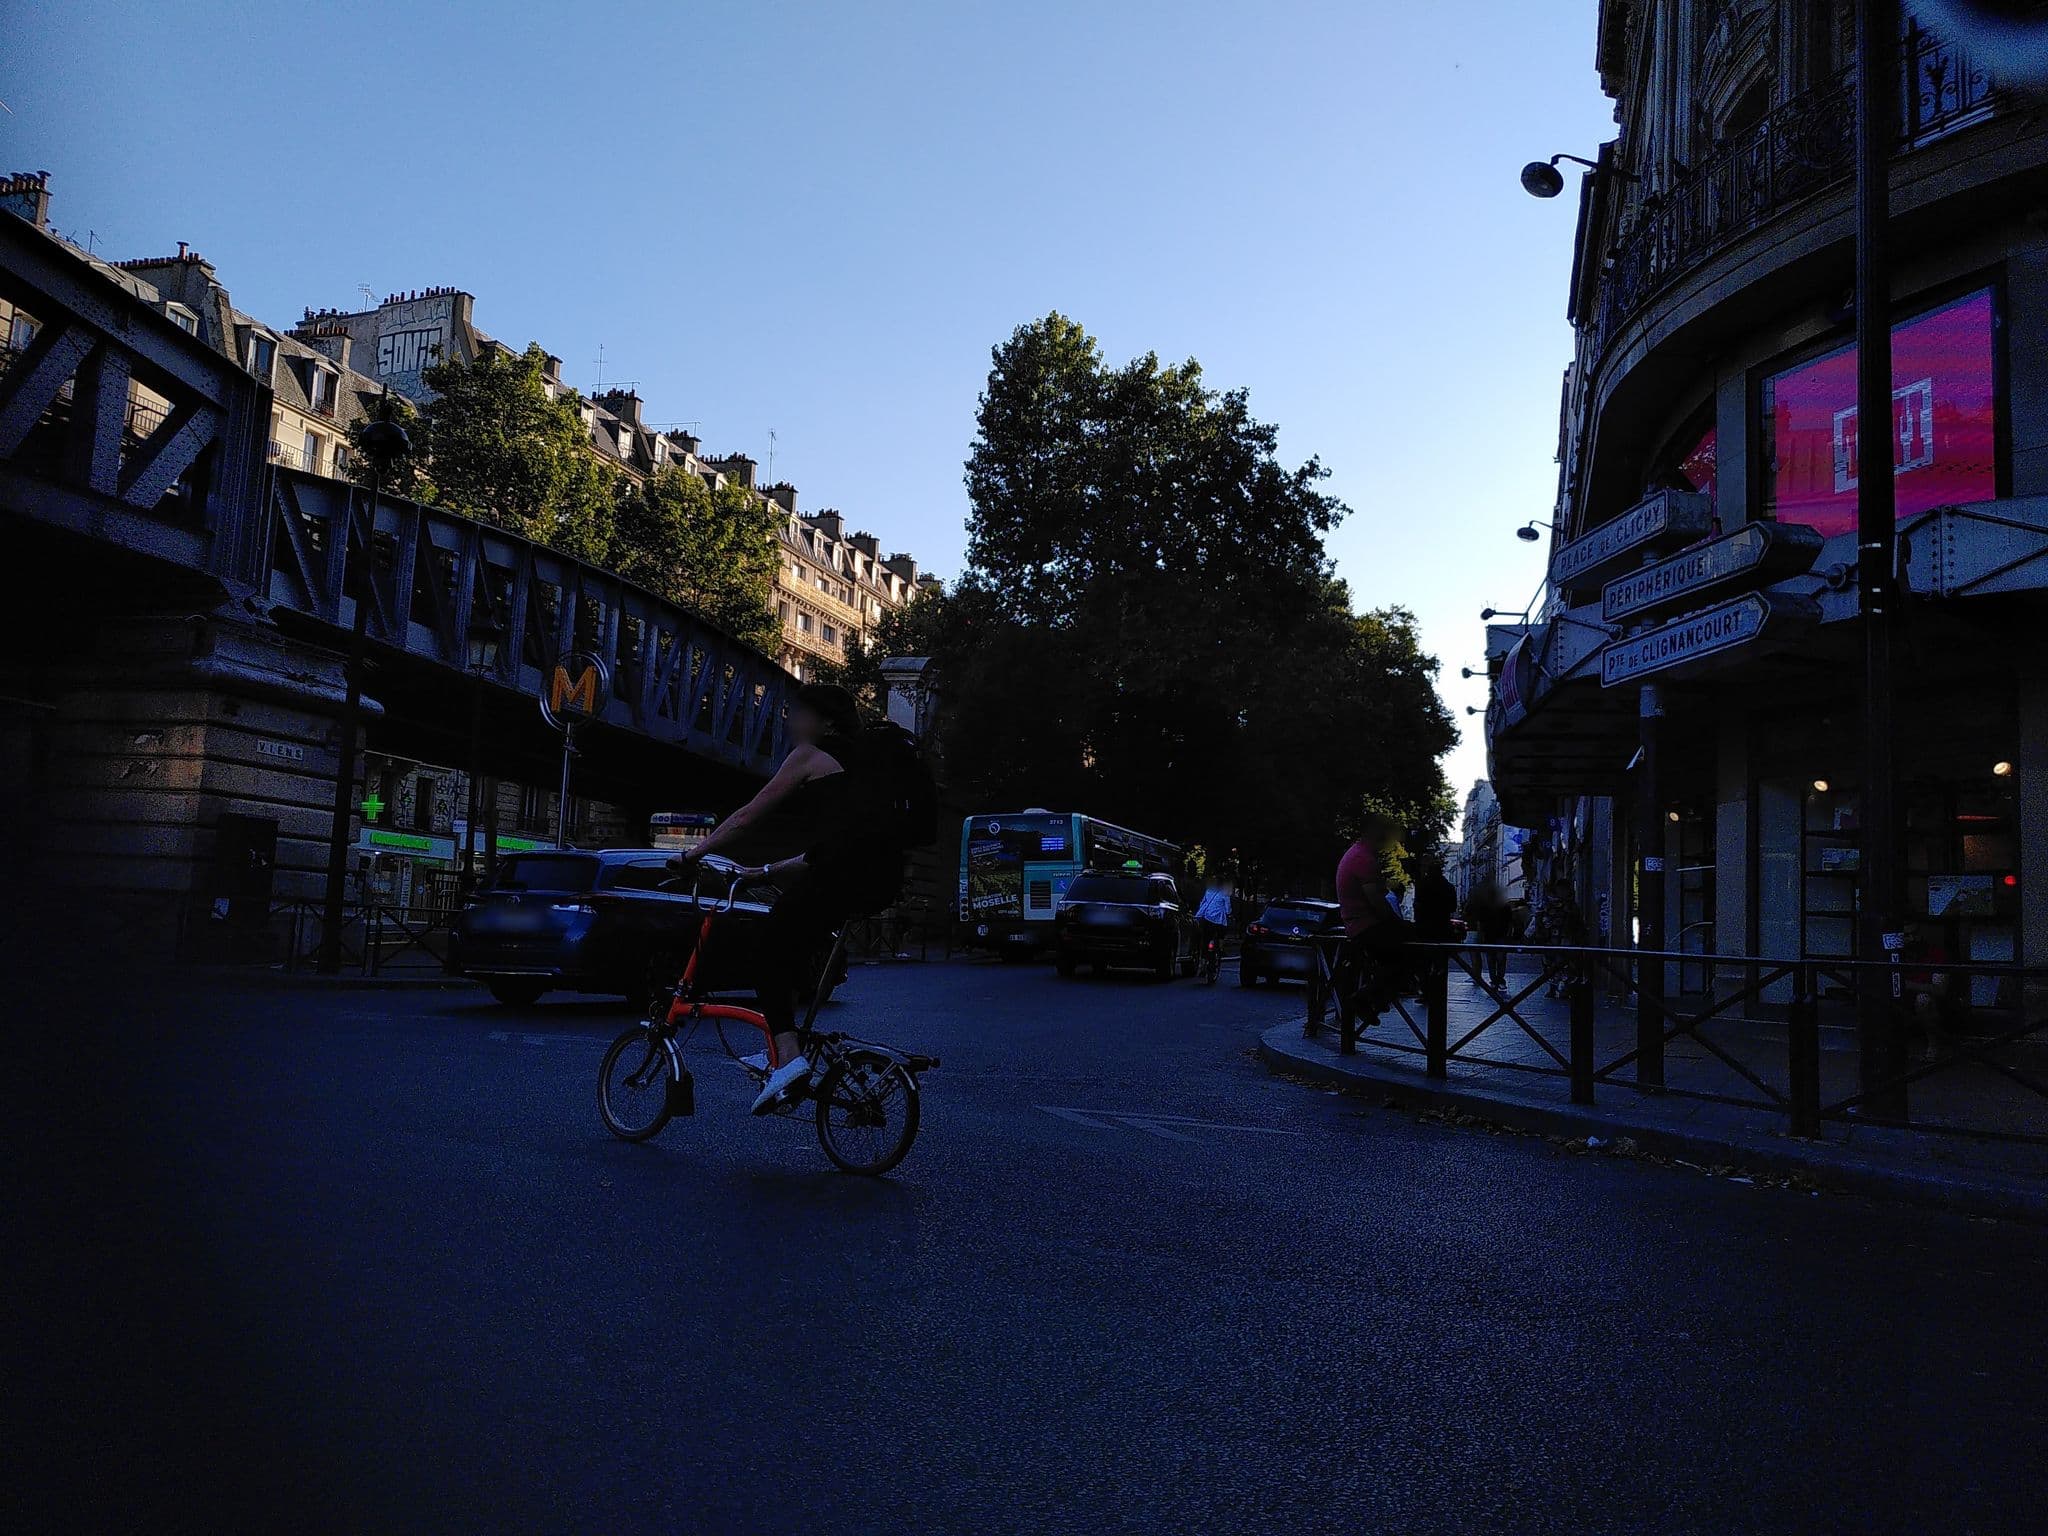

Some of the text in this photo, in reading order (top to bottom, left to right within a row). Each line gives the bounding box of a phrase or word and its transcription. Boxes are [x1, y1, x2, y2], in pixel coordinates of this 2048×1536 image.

[1560, 504, 1661, 570] PLACE DE CLICHY
[1609, 556, 1705, 609] PÉRIPHÉRIQUE
[1628, 654, 1639, 668] DE
[1641, 610, 1741, 663] CLIGNANCOURT
[550, 664, 599, 714] M
[972, 893, 1019, 910] MOSELLE
